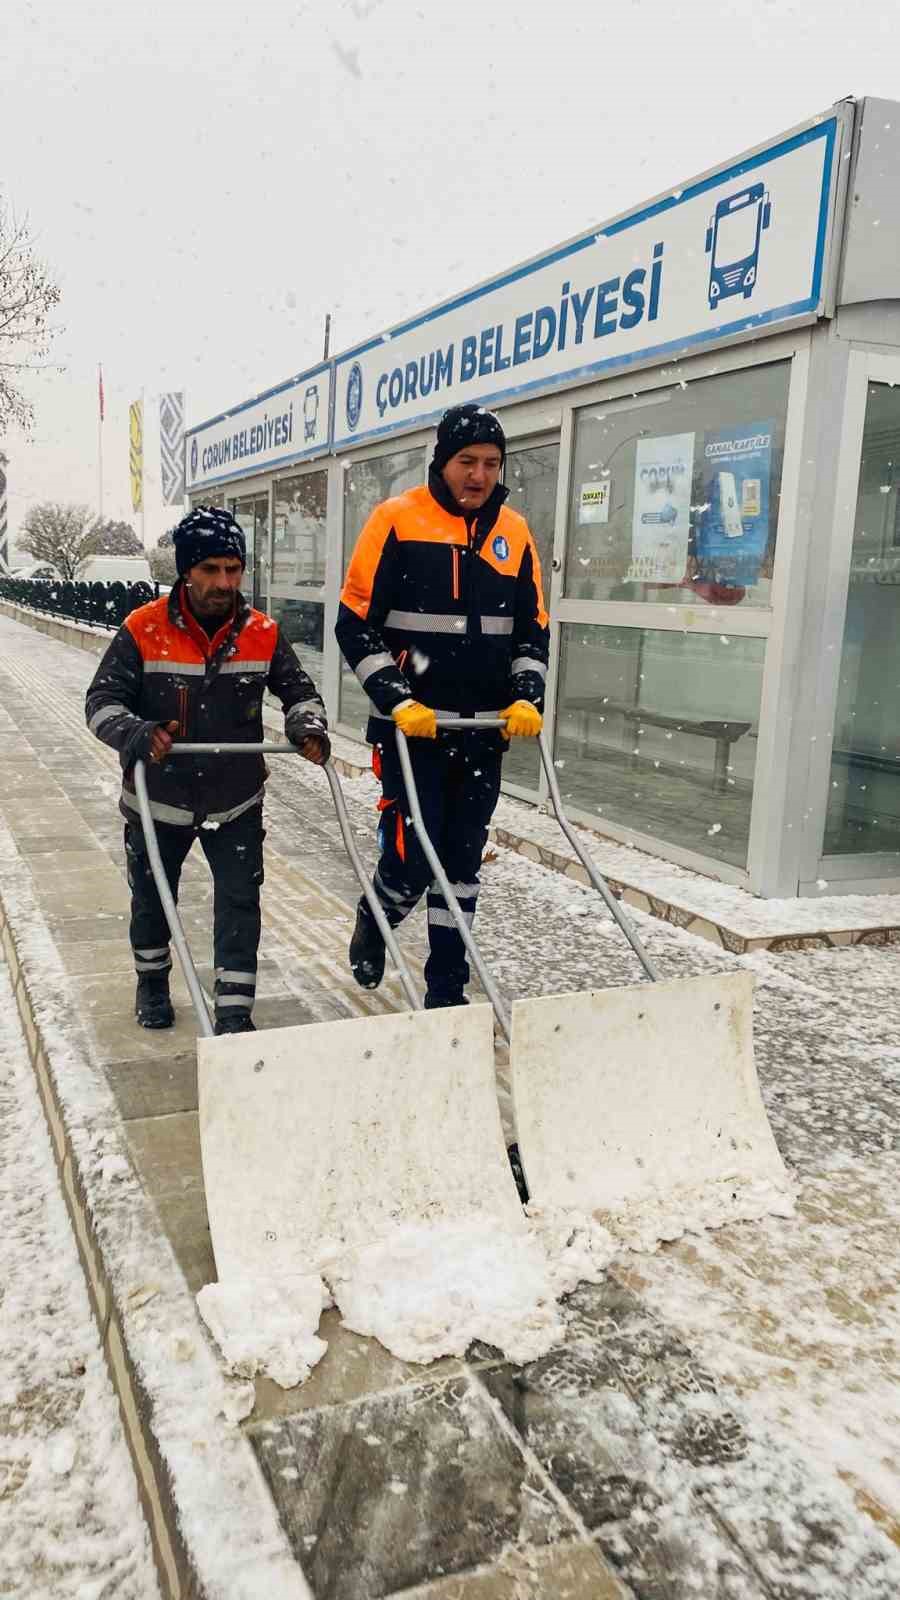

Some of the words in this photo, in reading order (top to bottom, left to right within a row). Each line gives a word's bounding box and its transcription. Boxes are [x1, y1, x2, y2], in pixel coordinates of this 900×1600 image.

[376, 345, 453, 418] ÇORUM
[460, 242, 664, 383] BELEDİYESİ
[202, 437, 231, 473] ÇORUM
[232, 400, 293, 460] BELEDİYESİ
